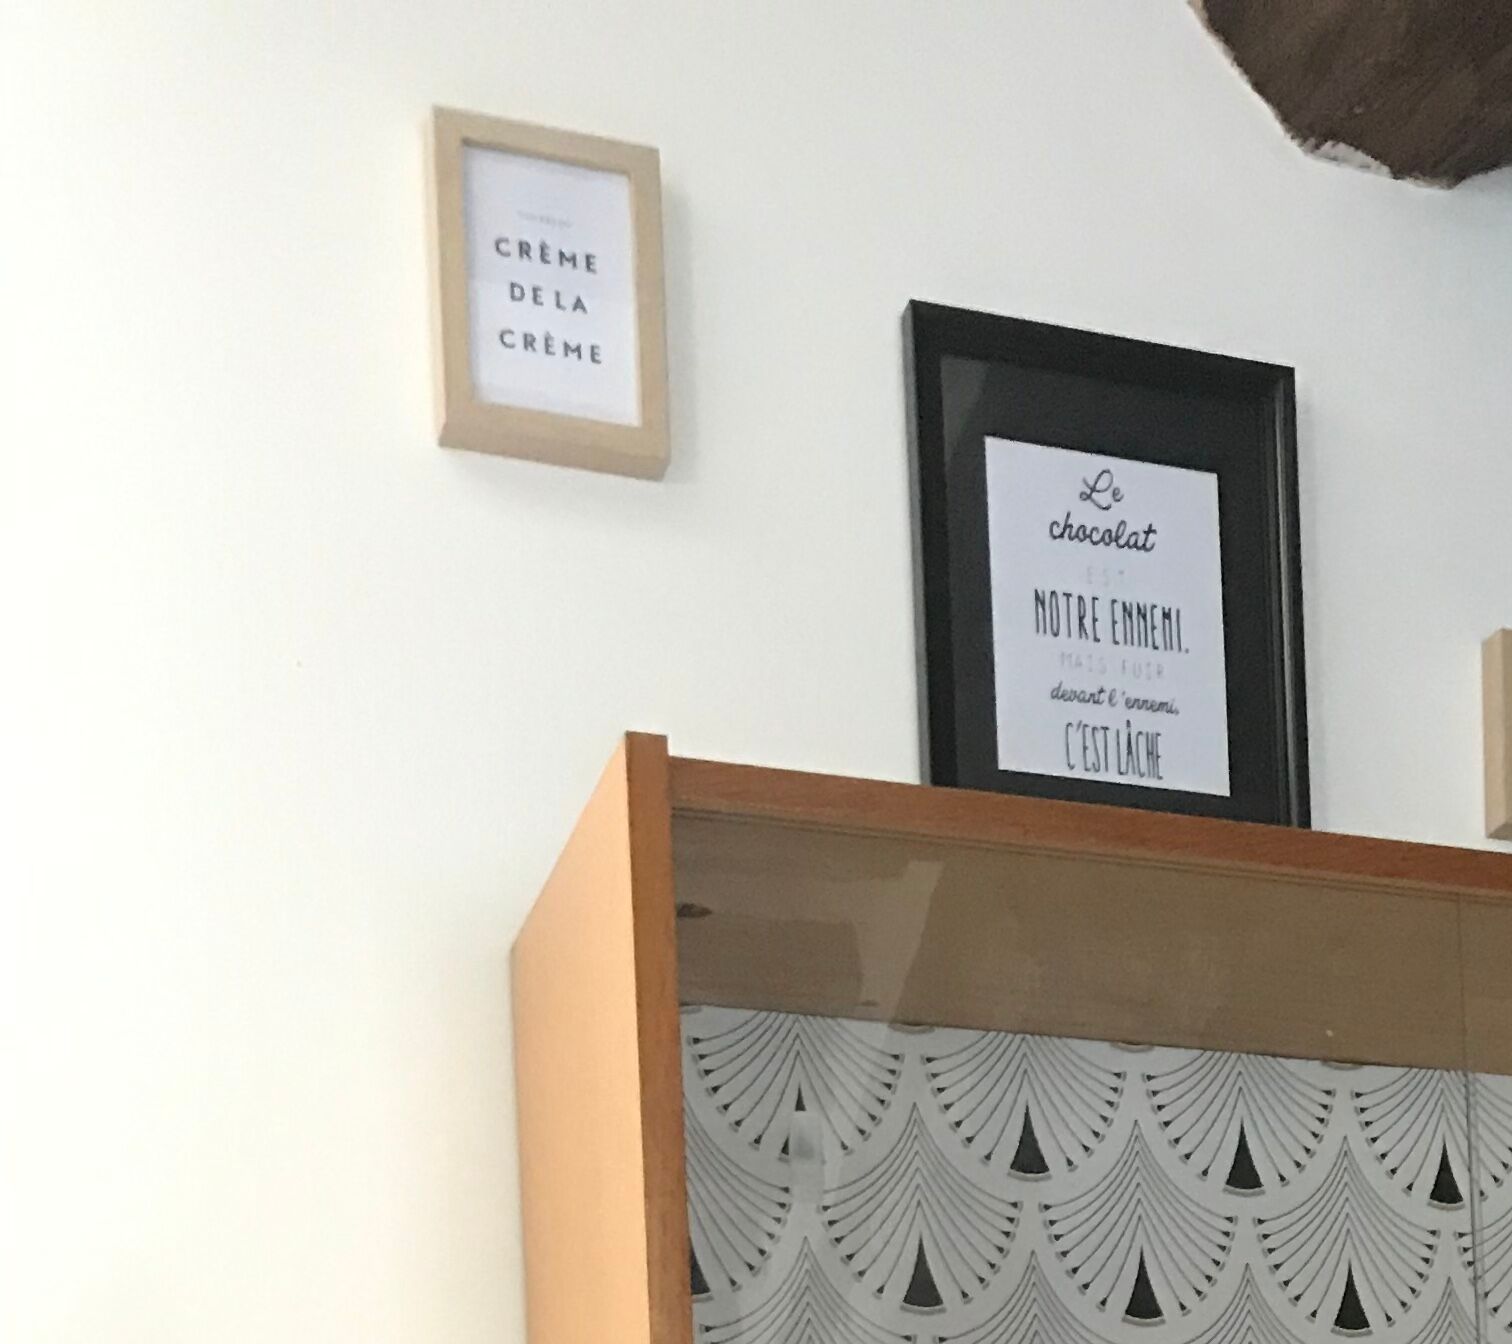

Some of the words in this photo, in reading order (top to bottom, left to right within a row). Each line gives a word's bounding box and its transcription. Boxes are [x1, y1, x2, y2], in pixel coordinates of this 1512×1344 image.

[495, 237, 597, 274] CRÈME
[499, 329, 602, 365] CRÈME
[1079, 468, 1124, 511] Le
[1049, 511, 1158, 552] chocolat
[1034, 588, 1101, 643] NOTRE
[1110, 597, 1191, 655] ENNEMI.
[1050, 680, 1106, 707] devant
[1064, 720, 1110, 773] C'EST
[1115, 719, 1165, 781] LÂCHE
